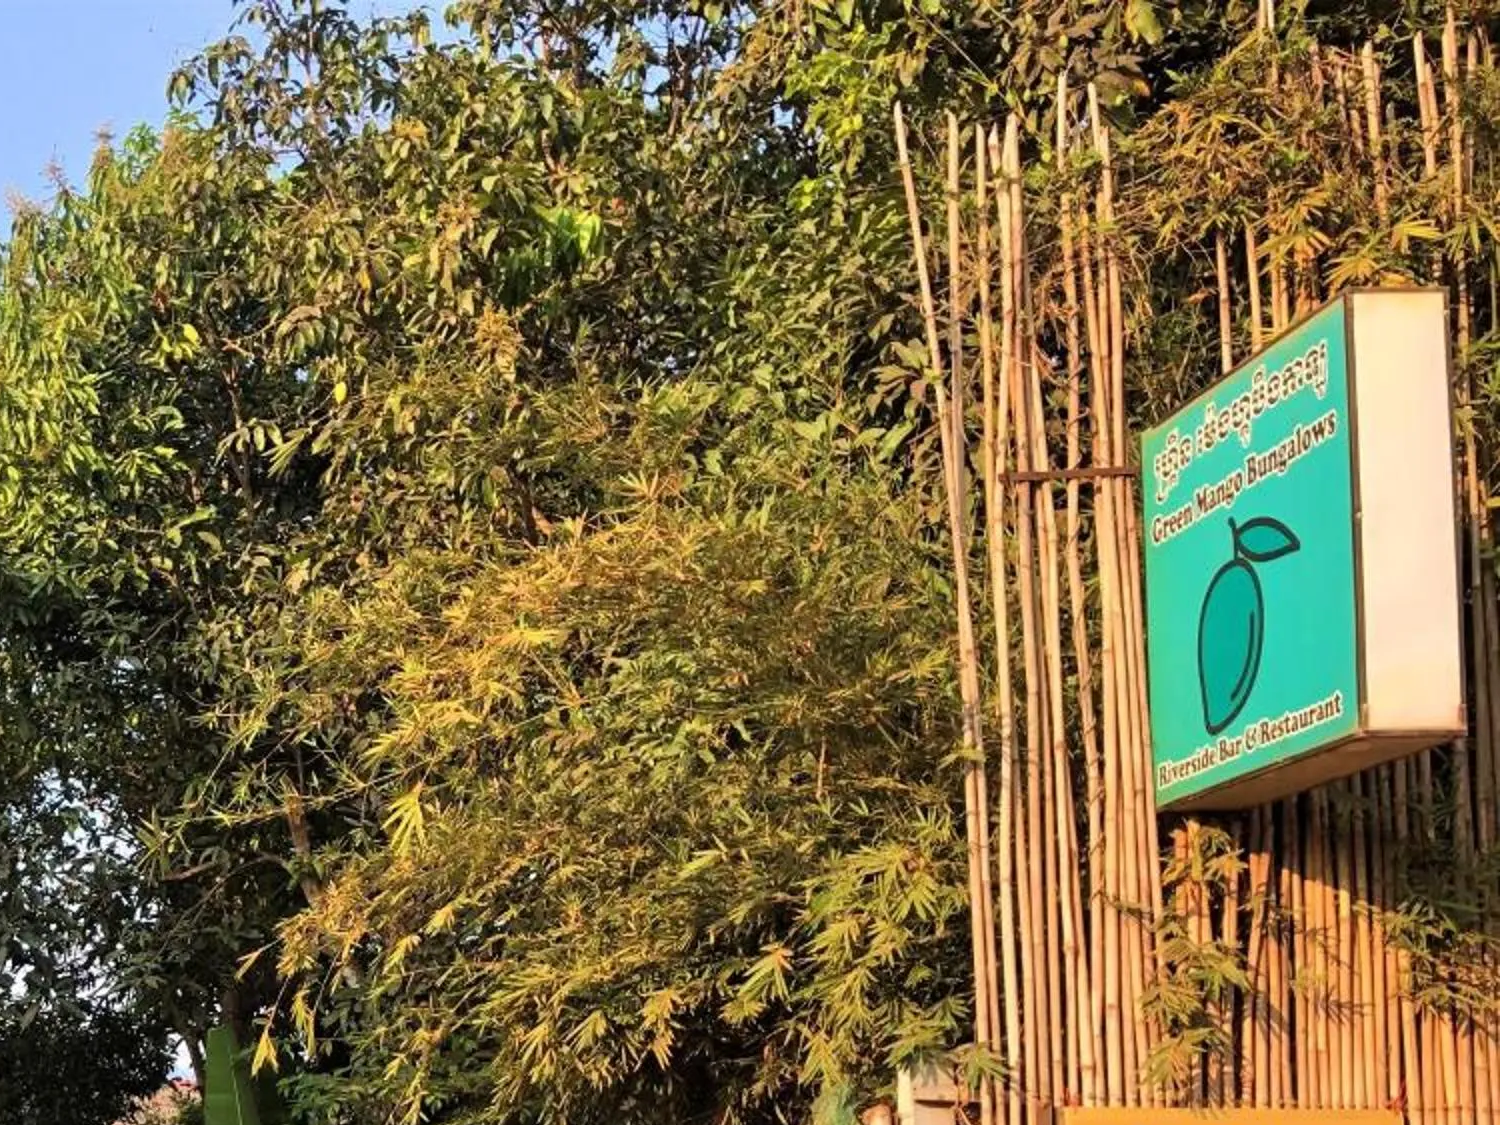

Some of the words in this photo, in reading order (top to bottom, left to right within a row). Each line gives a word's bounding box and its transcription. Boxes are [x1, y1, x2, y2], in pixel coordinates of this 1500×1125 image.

[1153, 504, 1192, 544] Green
[1195, 471, 1242, 508] Mango
[1246, 410, 1336, 486] Bungalows
[1158, 746, 1216, 787] Riverside
[1217, 735, 1243, 762] Bar
[1244, 724, 1258, 753] &
[1260, 692, 1341, 744] Restaurant
